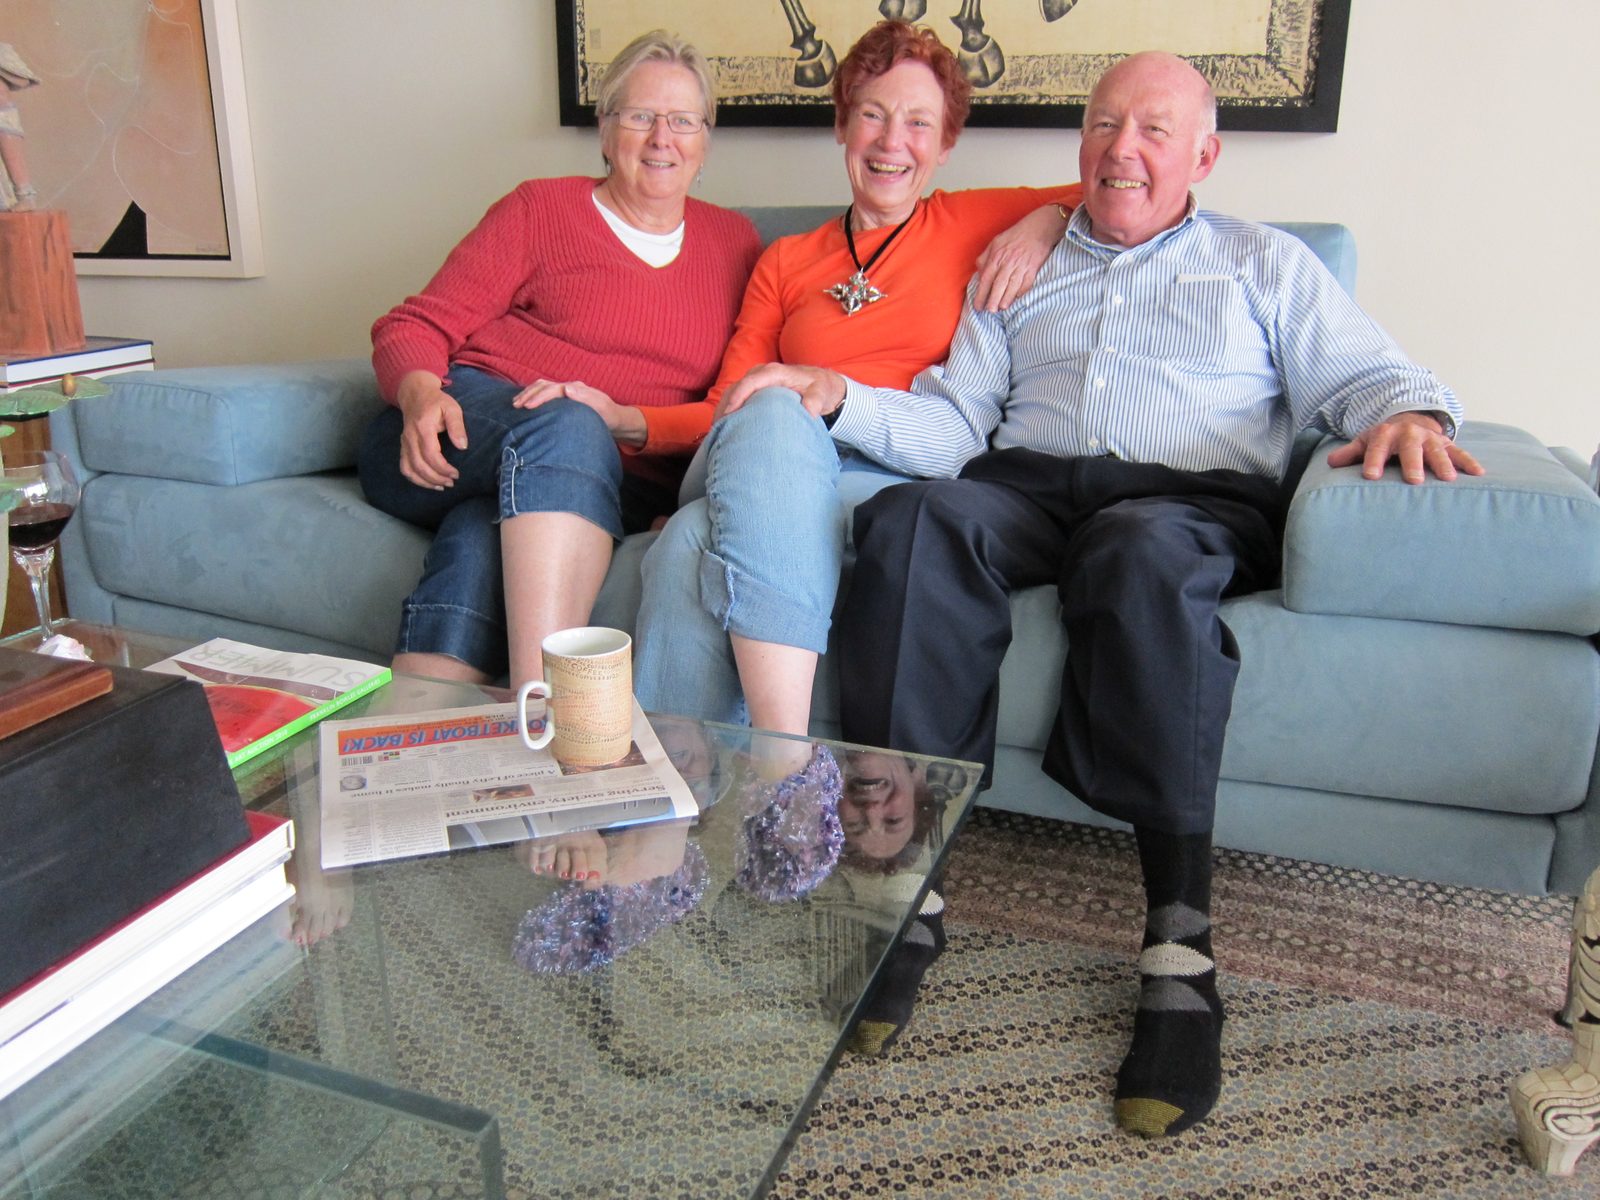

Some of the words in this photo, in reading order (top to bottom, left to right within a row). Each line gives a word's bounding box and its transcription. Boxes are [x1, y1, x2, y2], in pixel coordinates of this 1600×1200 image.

[189, 646, 368, 688] SUMMER
[343, 733, 404, 753] BACK!
[407, 730, 427, 745] IS
[516, 769, 545, 779] piece
[607, 784, 667, 797] Serving
[549, 792, 604, 805] society,
[446, 800, 545, 817] environment
